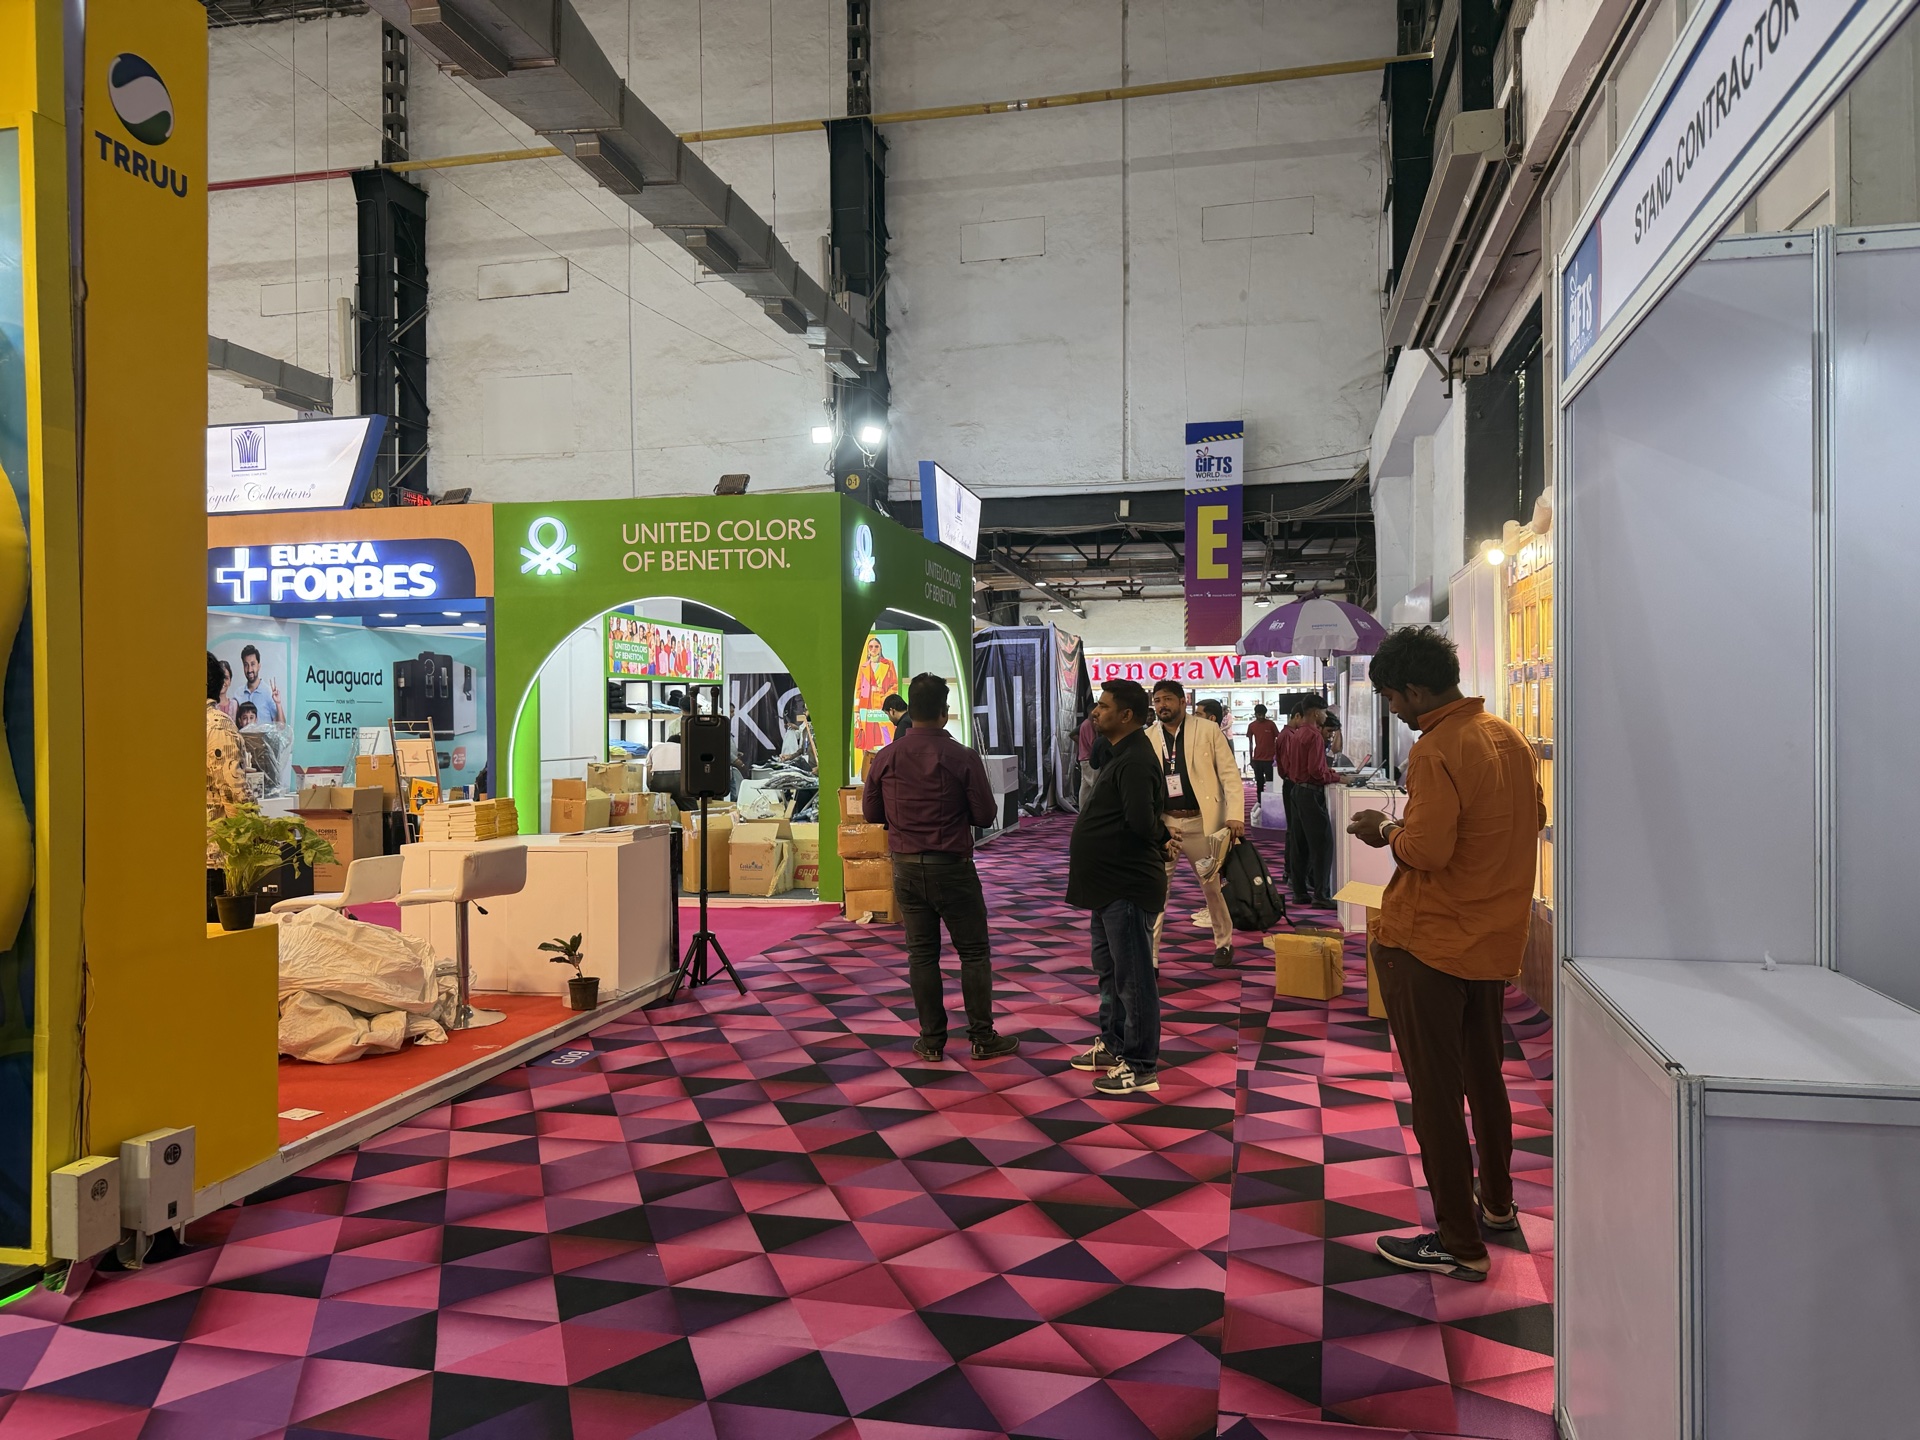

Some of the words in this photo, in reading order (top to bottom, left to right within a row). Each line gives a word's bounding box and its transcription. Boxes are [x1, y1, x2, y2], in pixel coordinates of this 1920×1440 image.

[95, 130, 188, 198] TRRUU
[1634, 156, 1674, 245] STAND
[207, 486, 240, 510] oyale
[244, 482, 312, 502] Collections
[622, 521, 711, 545] UNITED
[717, 518, 817, 542] COLORS
[1197, 505, 1228, 579] E
[270, 542, 379, 566] EUREKA
[622, 551, 656, 573] OF
[661, 547, 791, 572] BENETTON.
[270, 563, 437, 601] FORBES
[305, 665, 383, 692] Aquaguard
[306, 710, 321, 742] 2
[324, 712, 352, 724] YEAR
[551, 1050, 590, 1065] G09
